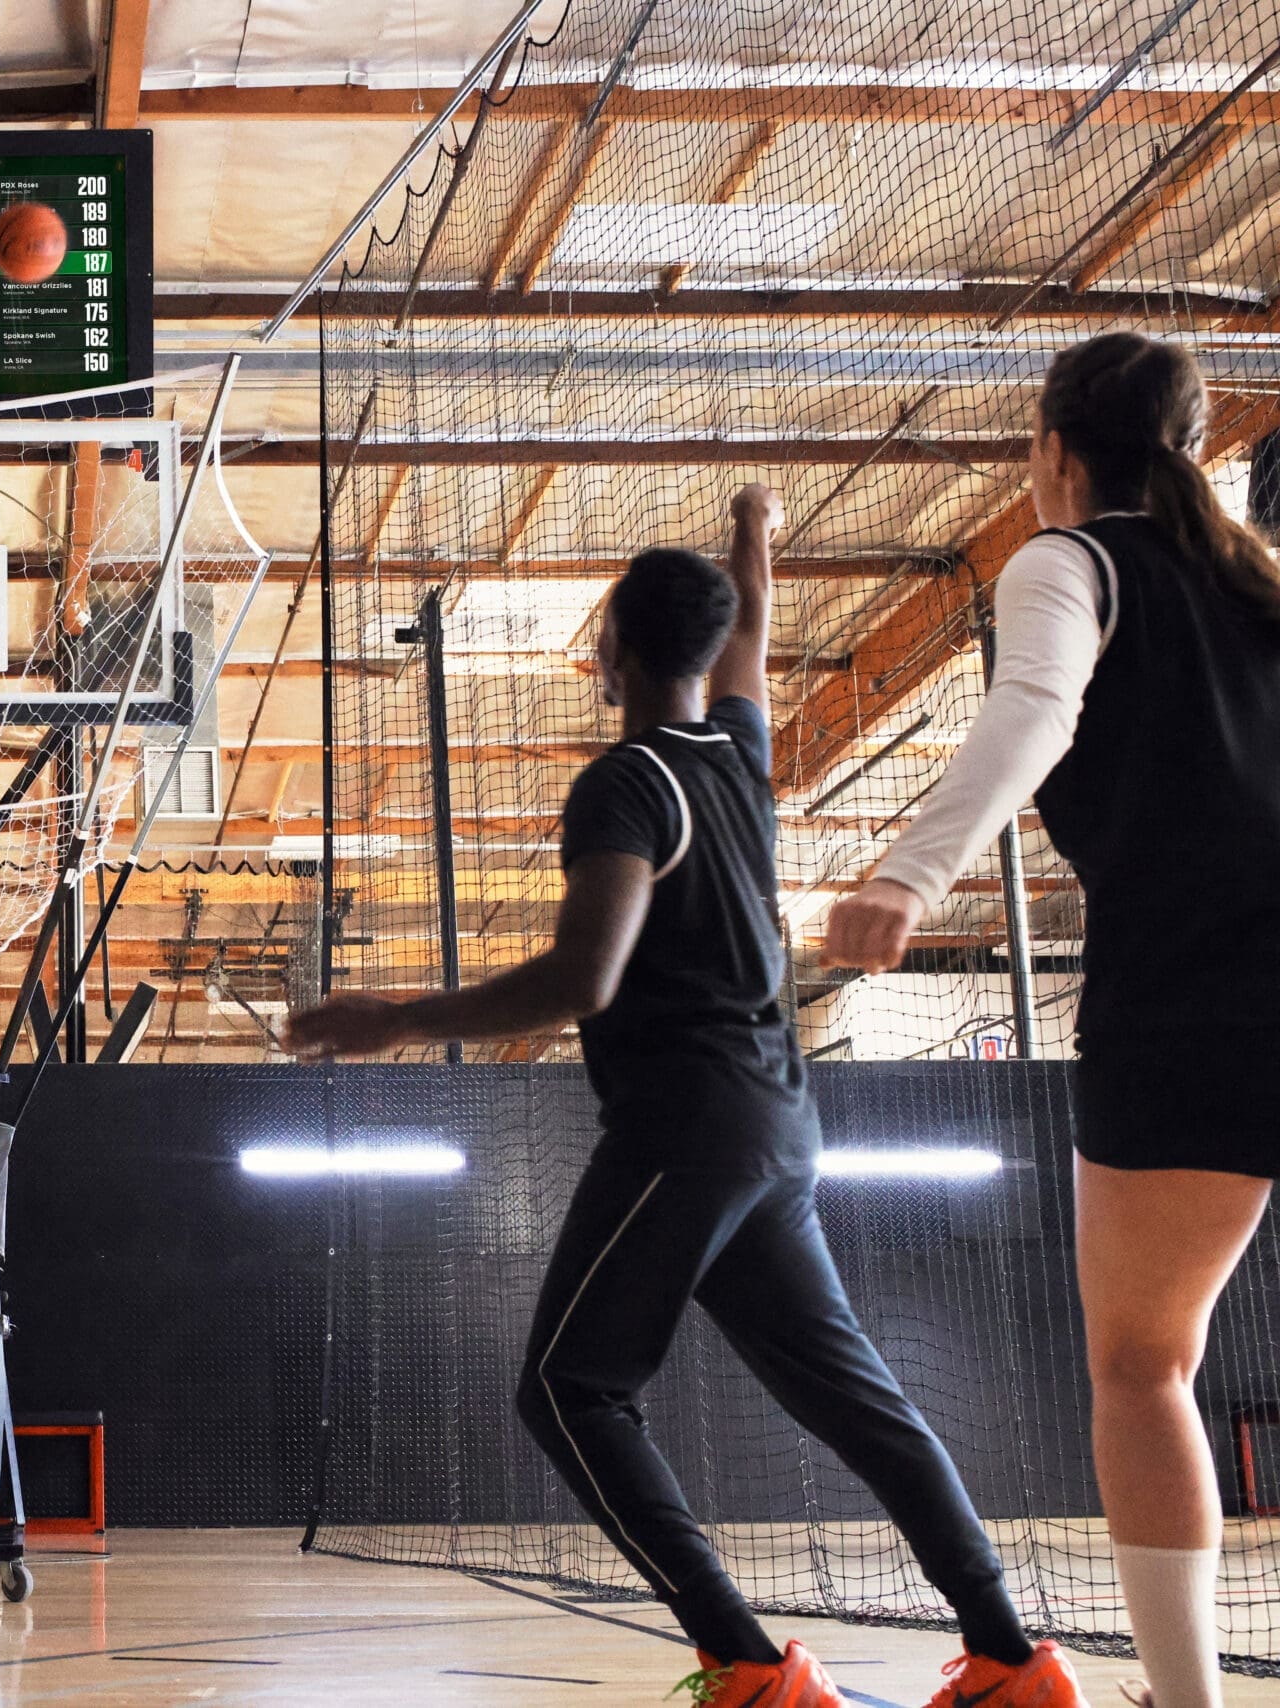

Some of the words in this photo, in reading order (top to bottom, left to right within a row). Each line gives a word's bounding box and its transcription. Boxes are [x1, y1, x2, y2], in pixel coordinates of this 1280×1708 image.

[77, 176, 107, 196] 200
[81, 202, 107, 222] 189
[81, 227, 107, 247] 180
[83, 252, 108, 273] 187
[41, 282, 72, 290] Grizzlies
[86, 278, 108, 297] 181
[33, 307, 68, 315] Signature
[84, 302, 108, 322] 175
[3, 332, 34, 340] Spokane
[84, 327, 109, 347] 162
[84, 352, 109, 372] 150
[128, 448, 143, 472] 4
